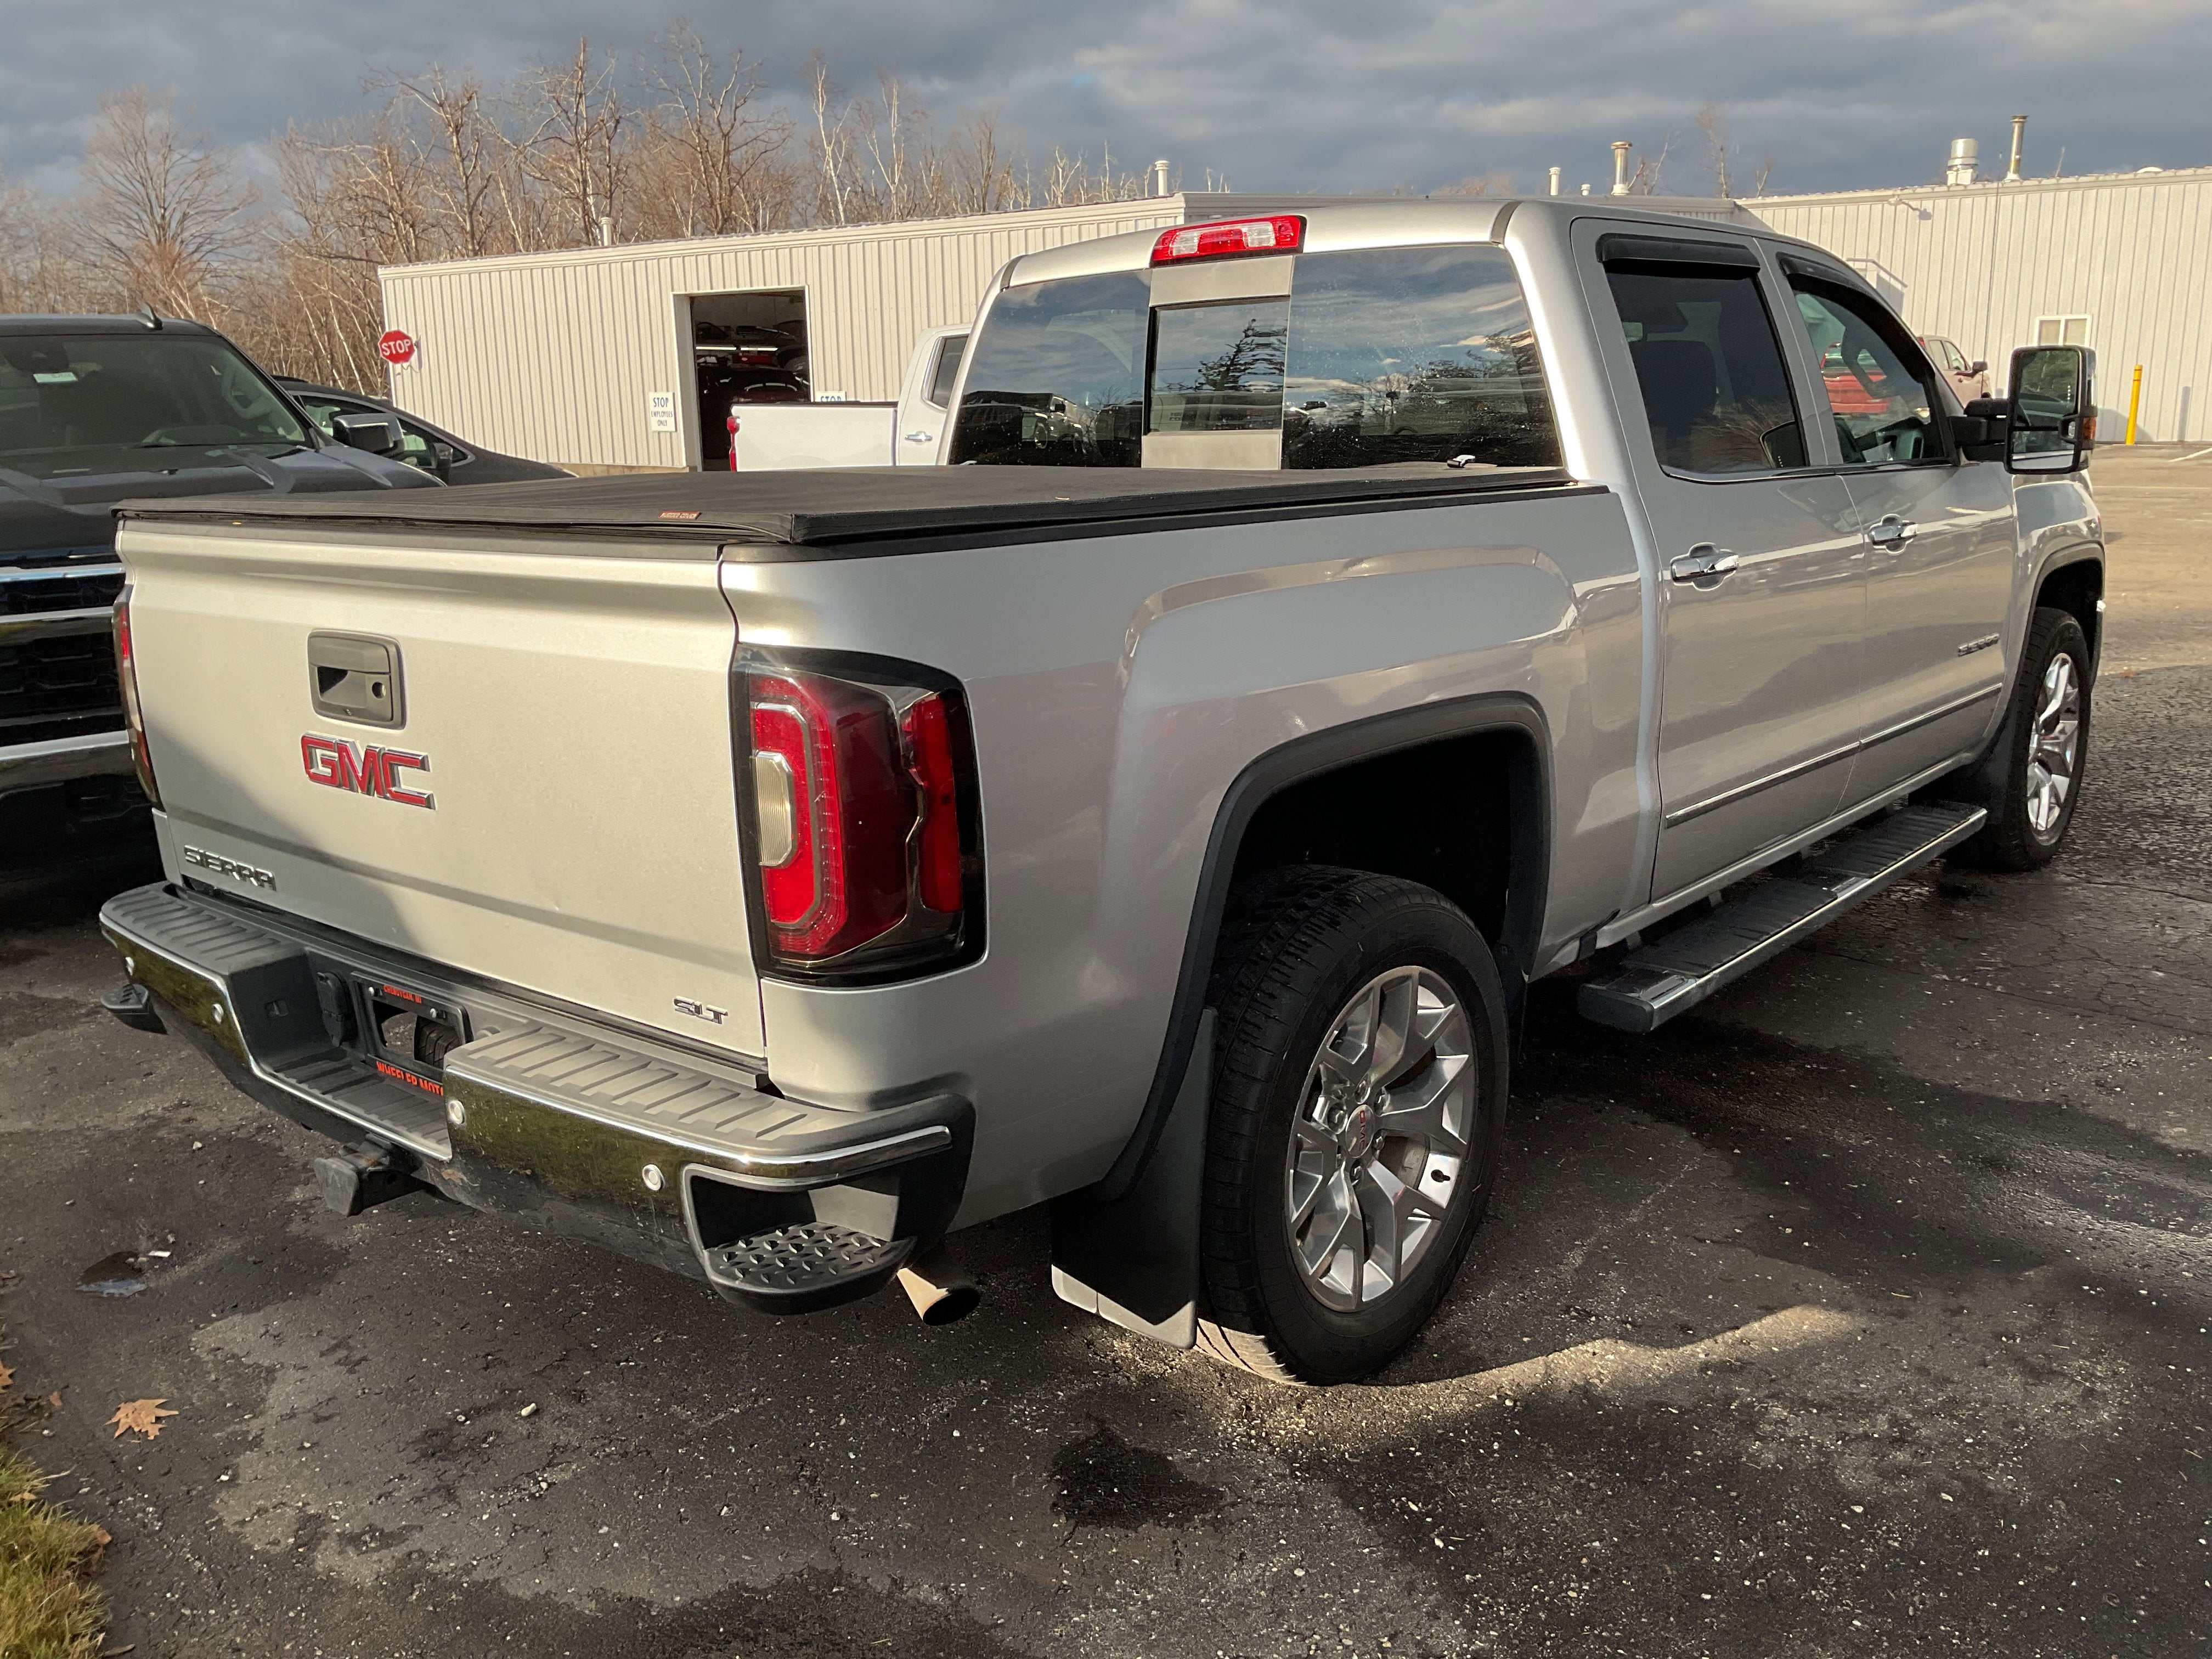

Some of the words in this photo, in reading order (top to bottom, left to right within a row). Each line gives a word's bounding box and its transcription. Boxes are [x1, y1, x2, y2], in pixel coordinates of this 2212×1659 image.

[381, 338, 410, 356] STOP
[653, 397, 669, 408] STOP
[300, 731, 437, 811] GMC
[183, 844, 277, 892] SIERRA
[673, 996, 729, 1025] SLT
